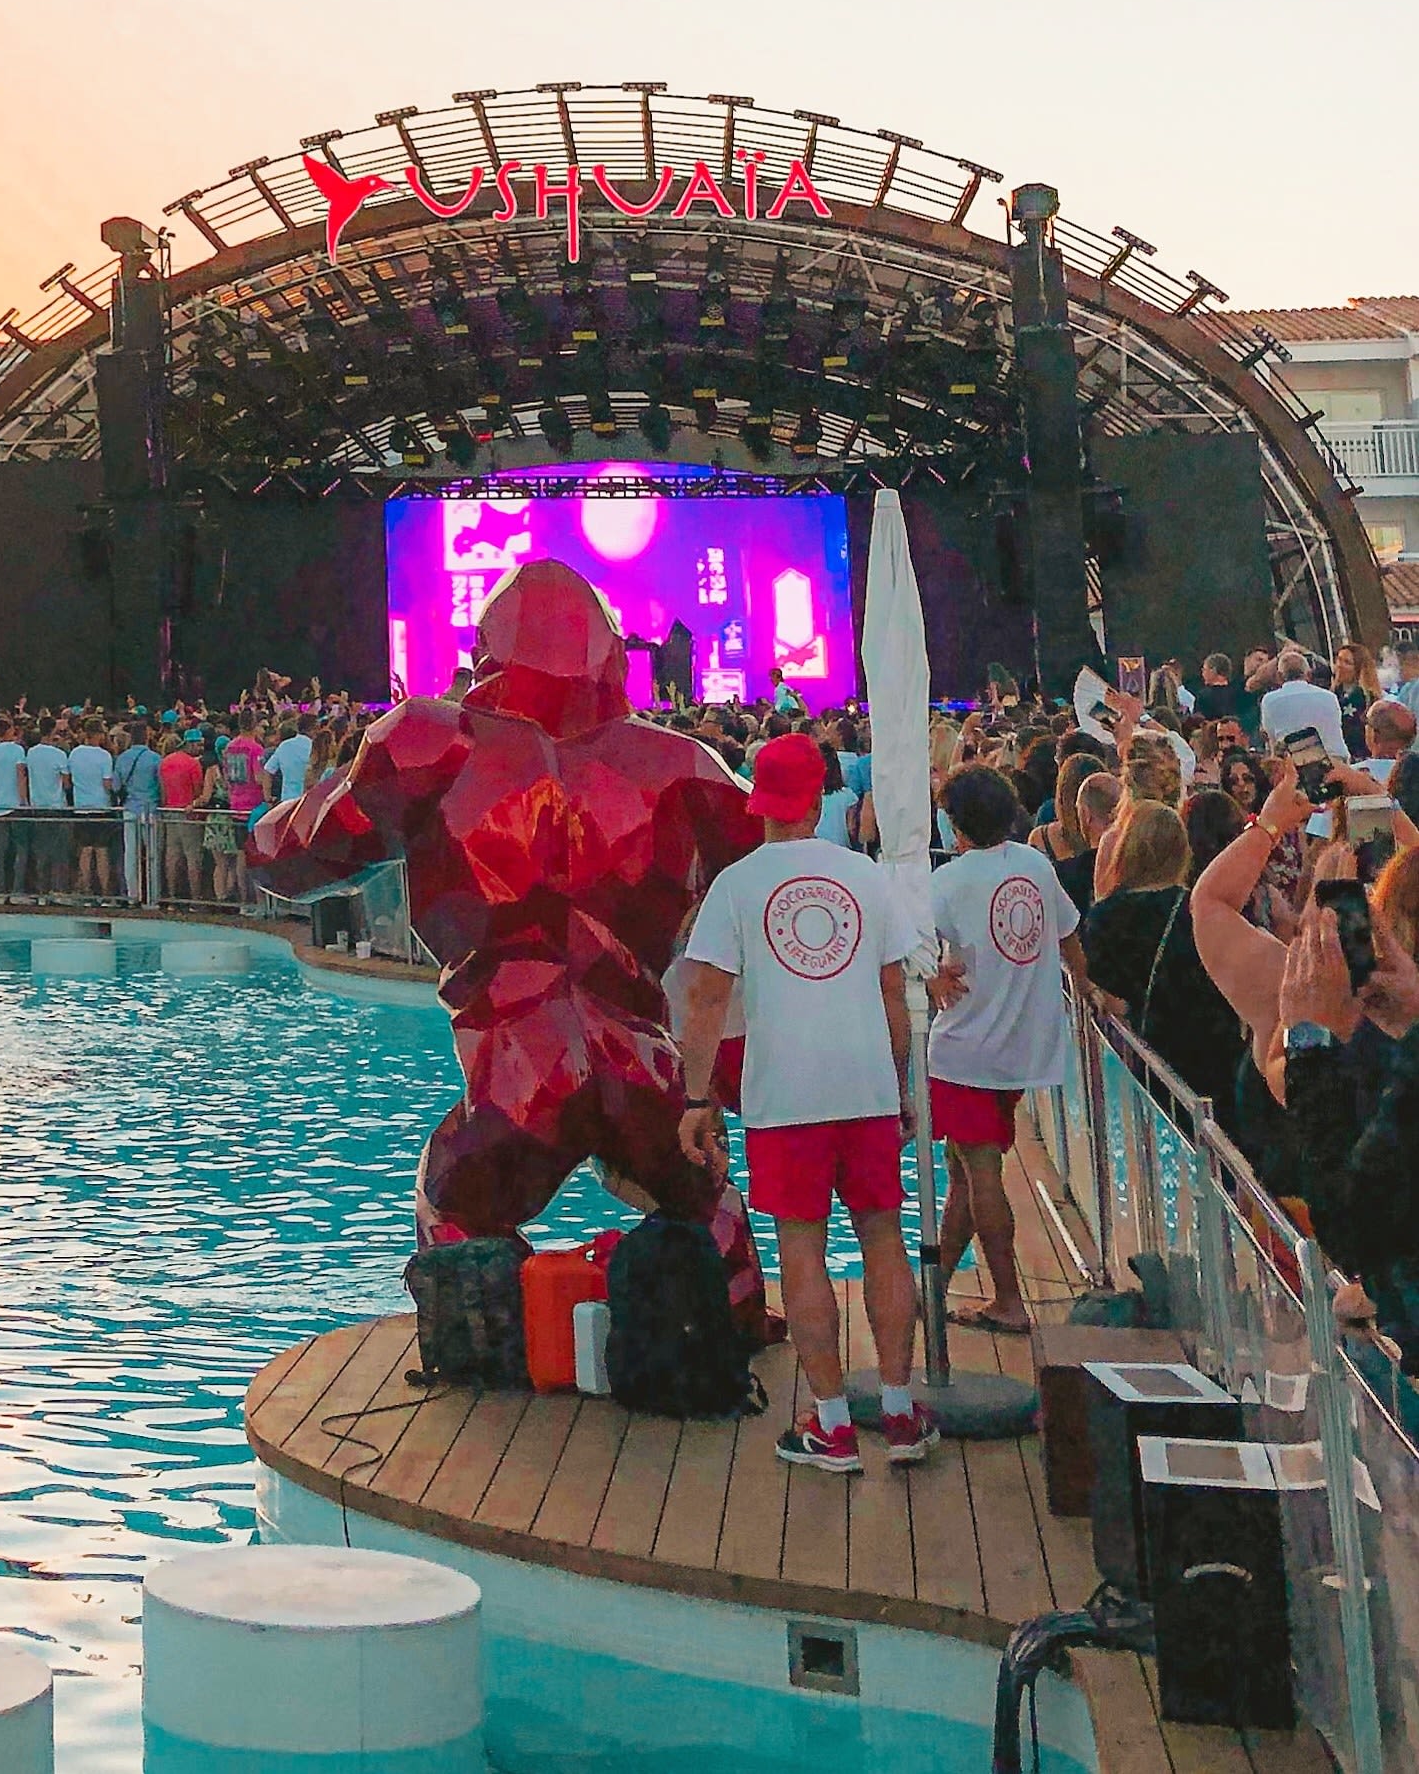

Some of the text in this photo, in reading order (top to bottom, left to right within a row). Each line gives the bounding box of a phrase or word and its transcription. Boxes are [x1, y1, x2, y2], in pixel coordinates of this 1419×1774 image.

[404, 148, 833, 263] USHUAÏA
[772, 886, 852, 919] SOCORRISTA
[784, 935, 849, 969] LIFEGUARD
